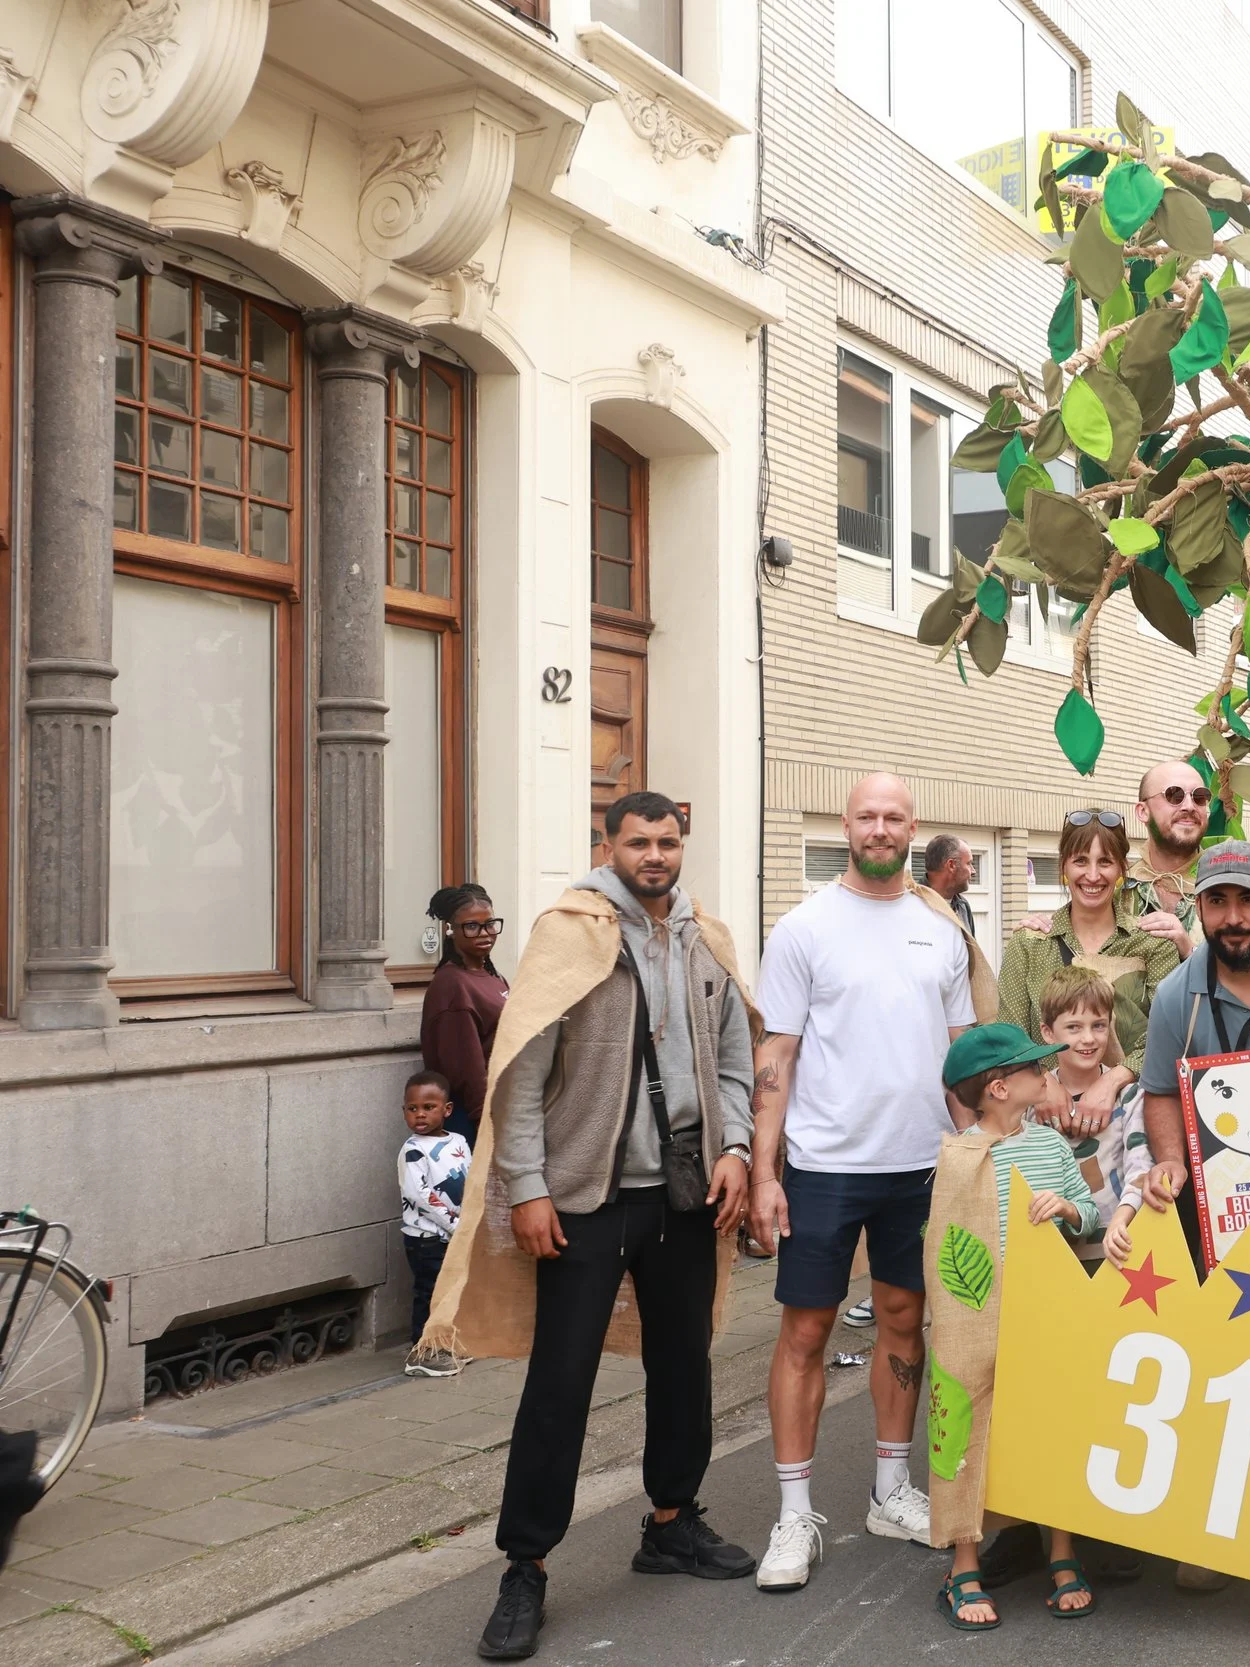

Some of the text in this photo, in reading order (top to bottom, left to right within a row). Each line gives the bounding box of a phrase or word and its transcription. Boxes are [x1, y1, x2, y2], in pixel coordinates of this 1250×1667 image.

[541, 666, 573, 703] 82
[1189, 1133, 1207, 1209] LANG ZULLEN ZE LEVEN
[1238, 1184, 1247, 1192] 25
